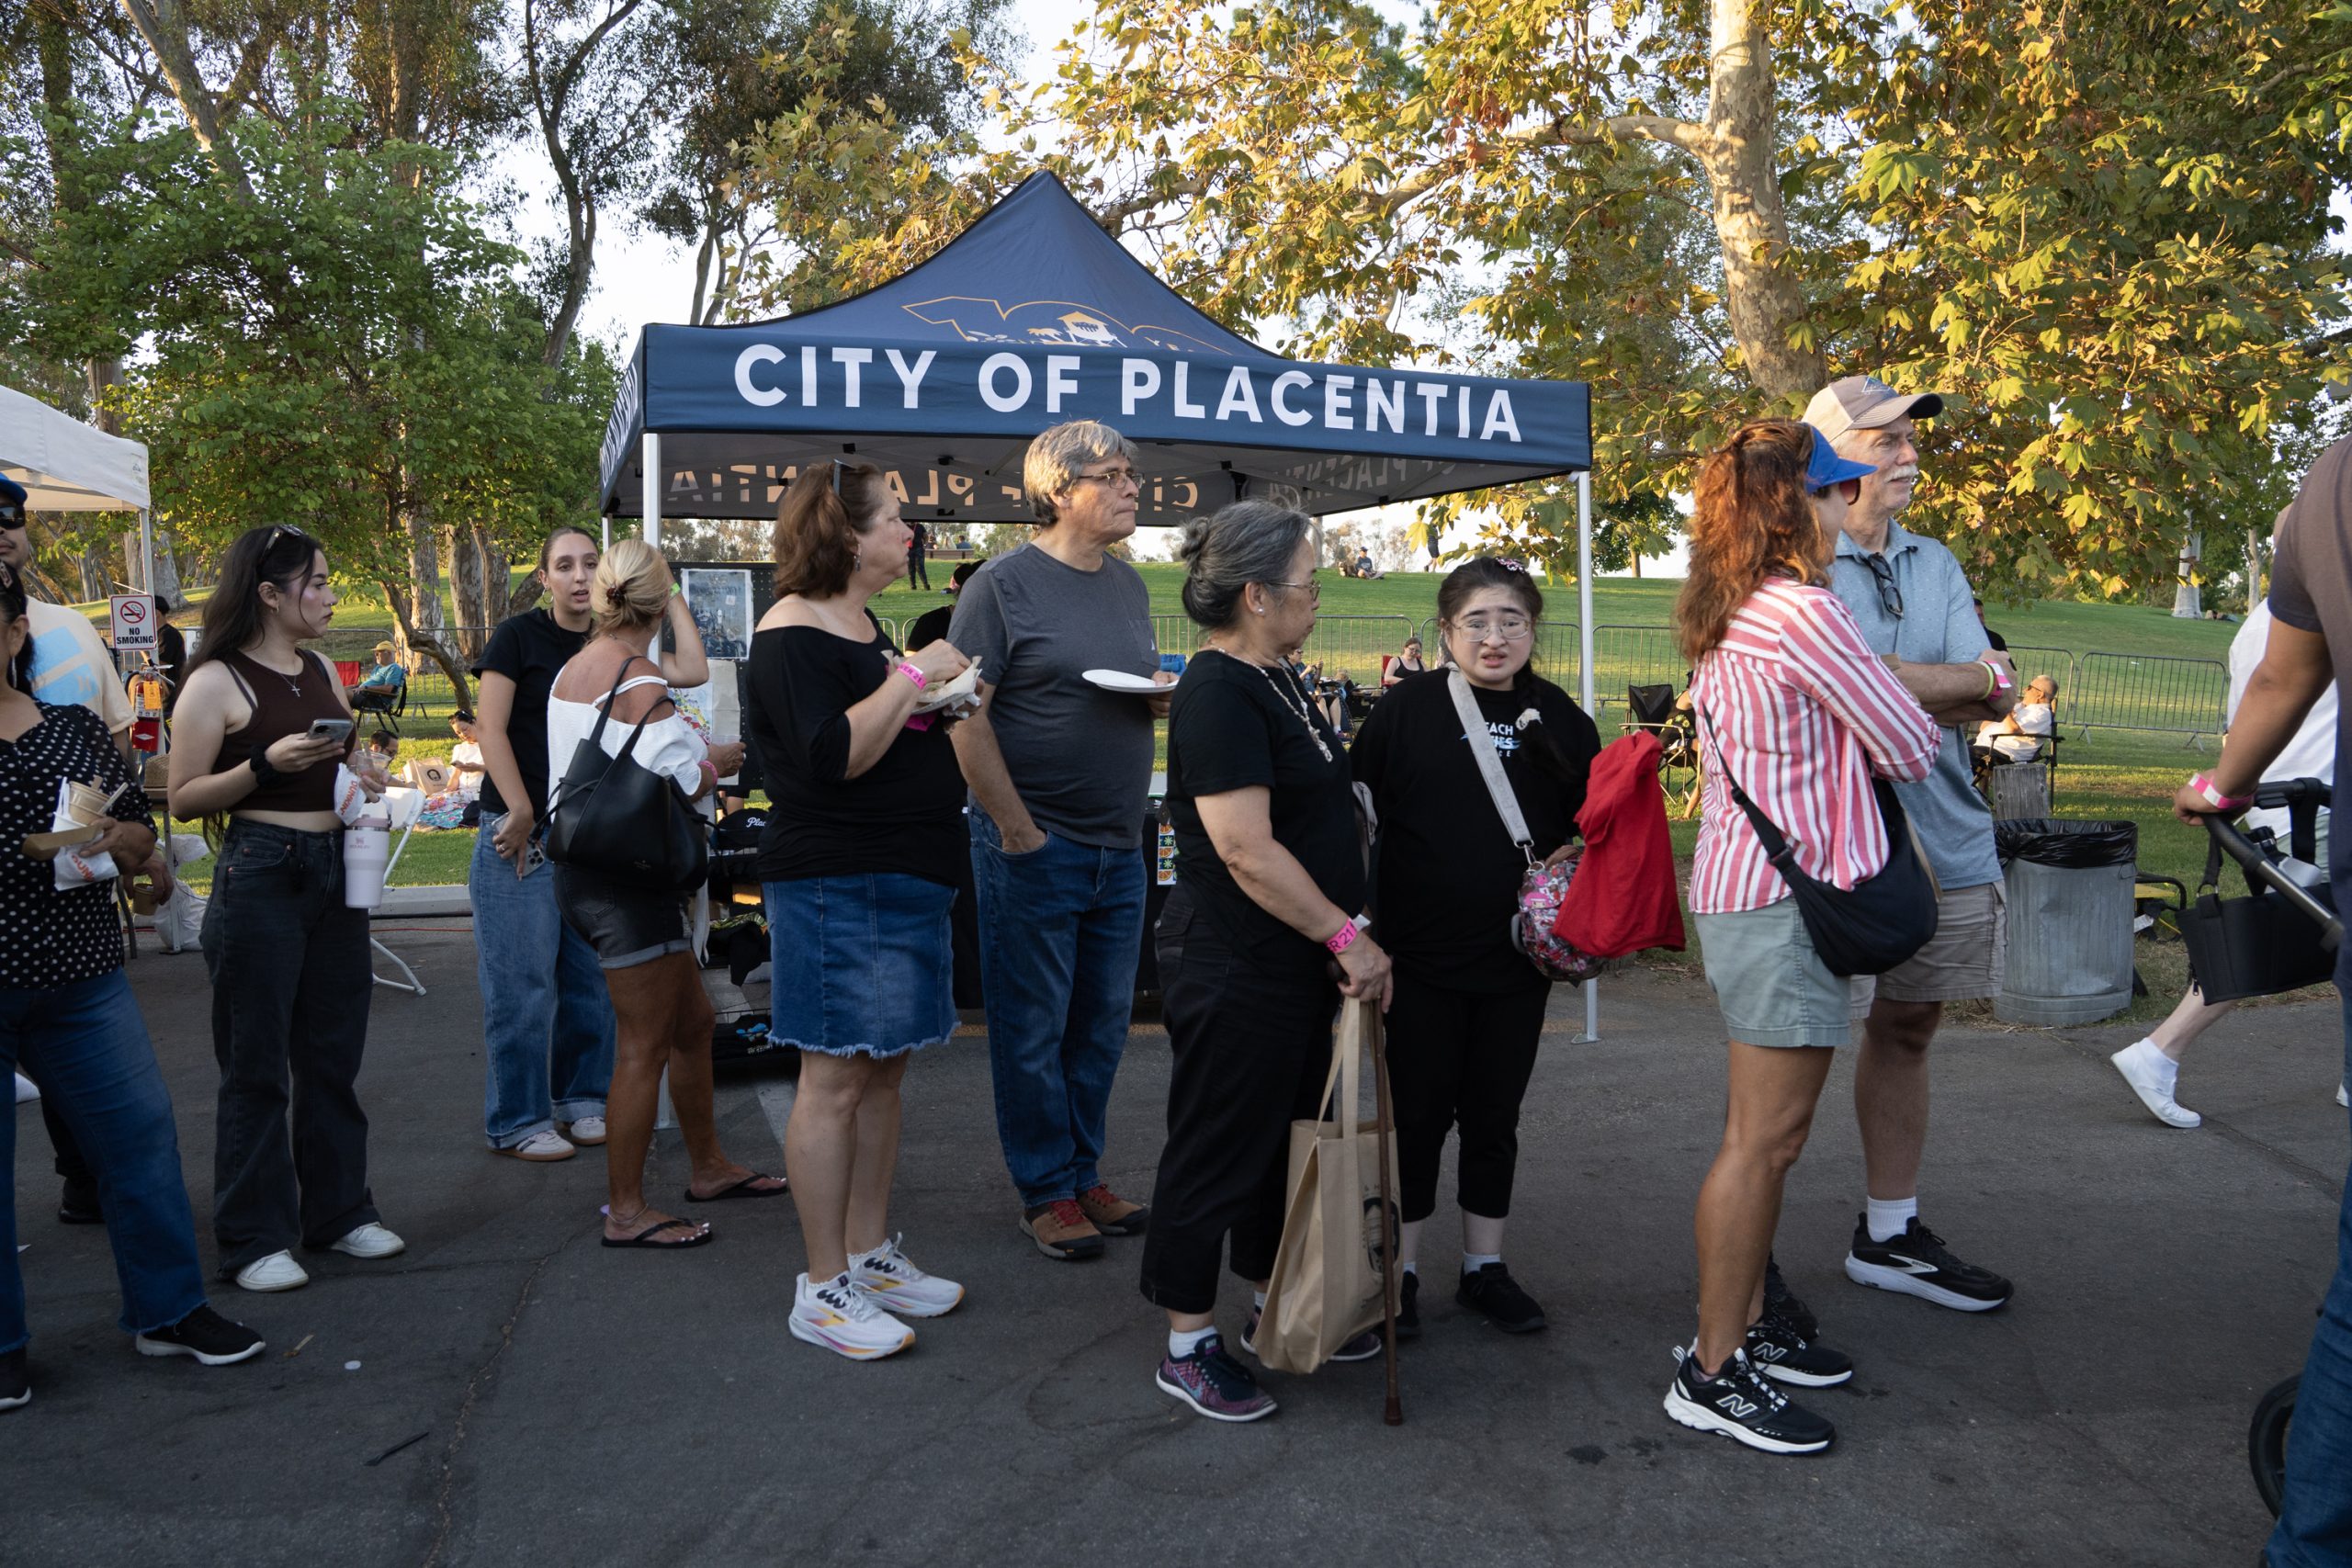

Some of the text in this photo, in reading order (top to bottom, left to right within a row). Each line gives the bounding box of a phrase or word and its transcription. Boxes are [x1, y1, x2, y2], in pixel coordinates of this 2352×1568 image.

[734, 344, 1521, 443] CITY OF PLACENTIA
[129, 627, 141, 636] NO
[117, 636, 153, 645] SMOKING
[1339, 928, 1353, 945] 21
